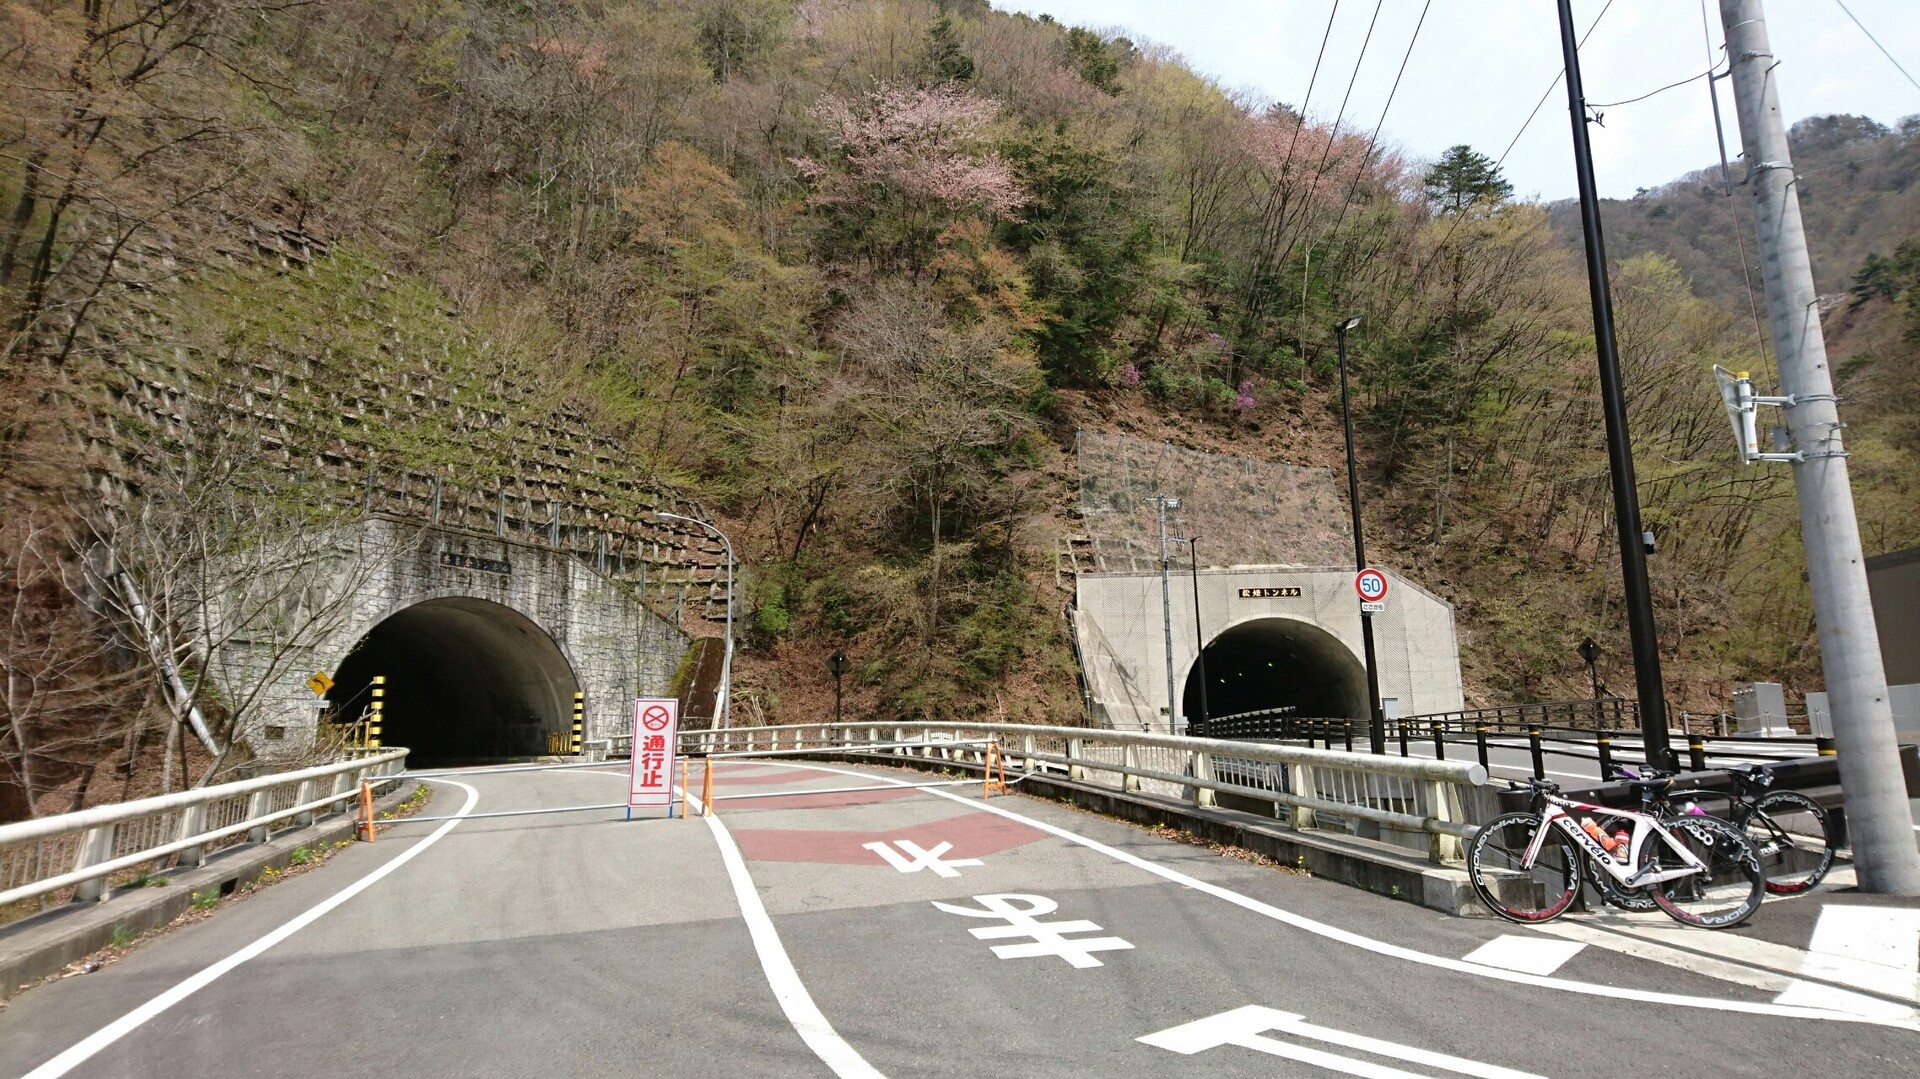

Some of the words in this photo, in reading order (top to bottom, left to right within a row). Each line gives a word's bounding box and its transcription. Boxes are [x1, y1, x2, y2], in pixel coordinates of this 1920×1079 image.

[1241, 588, 1298, 598] 松姫トンネル
[1362, 578, 1381, 593] 50
[640, 735, 665, 788] 通行止
[1473, 817, 1539, 886] CAMPAGNOLO
[1563, 819, 1611, 865] cervélo
[1562, 844, 1576, 890] BORA
[1701, 902, 1750, 925] BORA
